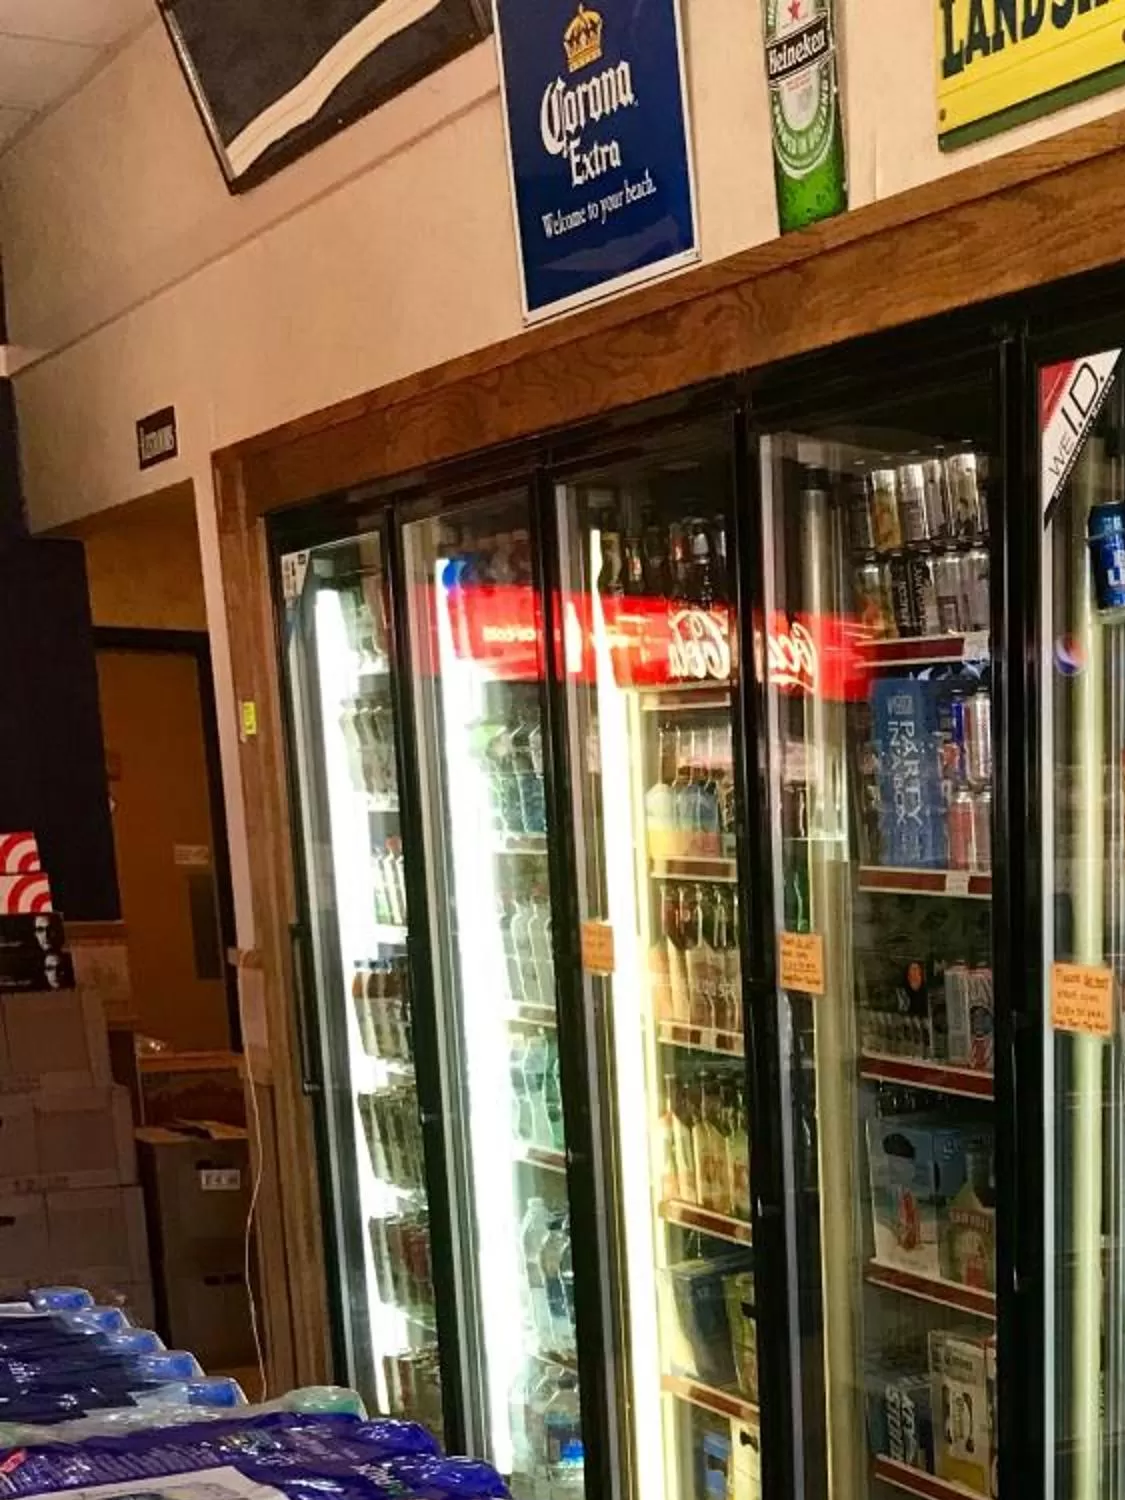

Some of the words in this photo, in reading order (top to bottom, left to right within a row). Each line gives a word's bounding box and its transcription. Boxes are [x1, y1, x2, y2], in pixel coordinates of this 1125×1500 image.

[769, 28, 826, 75] Heineken
[540, 60, 634, 159] Corona
[568, 136, 621, 187] Extra
[542, 208, 587, 238] Welcome
[587, 201, 599, 220] to
[599, 189, 625, 225] your
[1049, 432, 1075, 477] WE
